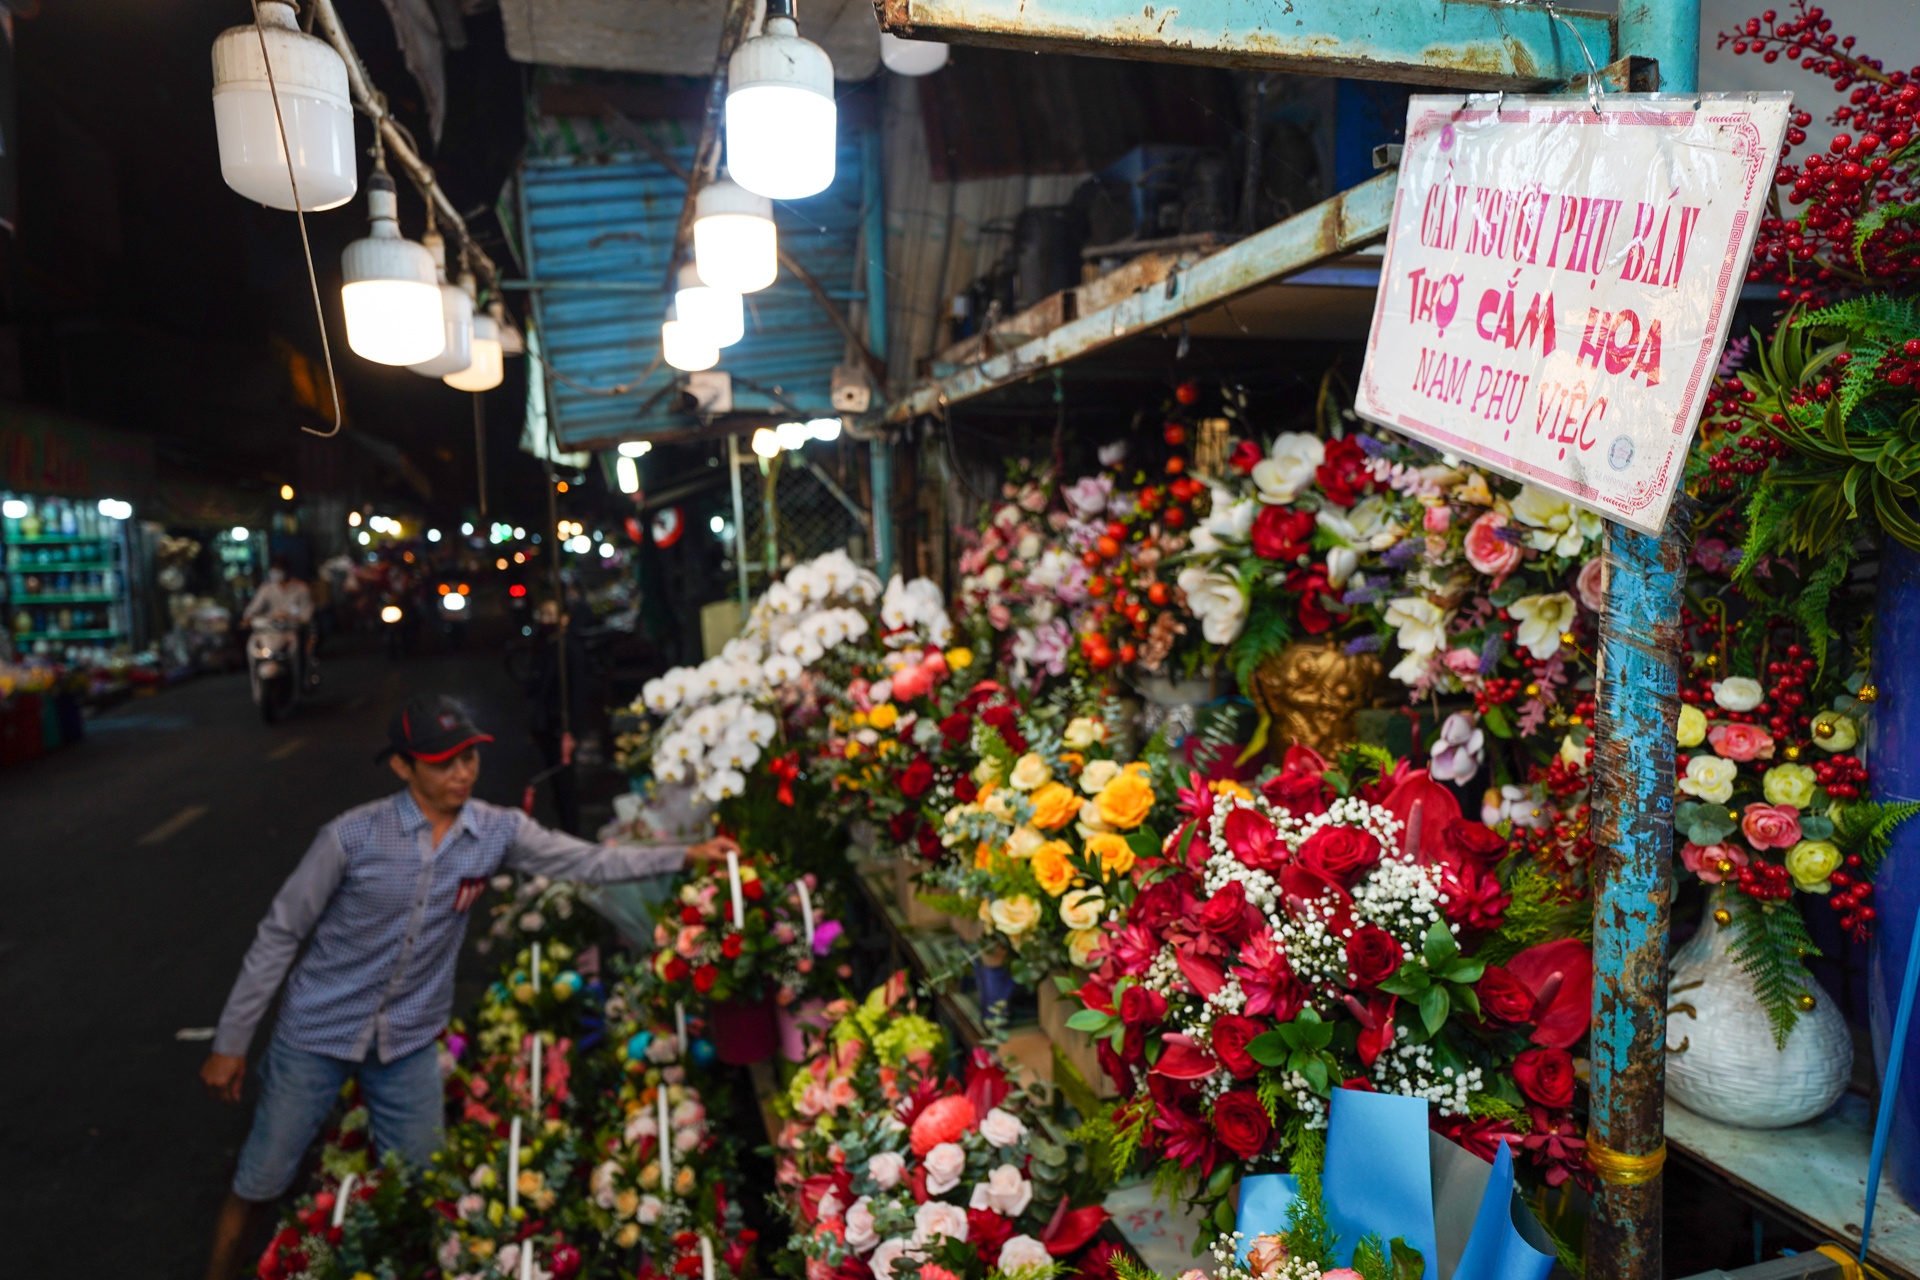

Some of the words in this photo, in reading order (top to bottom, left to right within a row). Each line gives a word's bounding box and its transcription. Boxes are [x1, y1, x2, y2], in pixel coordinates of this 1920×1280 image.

[1421, 158, 1468, 250] CẦN
[1546, 195, 1623, 290] PHỤ
[1619, 186, 1701, 289] BÁN
[1408, 267, 1464, 338] THỢ
[1476, 268, 1556, 358] CẮM
[1576, 307, 1661, 387] HOA
[1412, 347, 1472, 405] NAM
[1470, 365, 1529, 442] PHỤ
[1536, 380, 1608, 461] VIỆC
